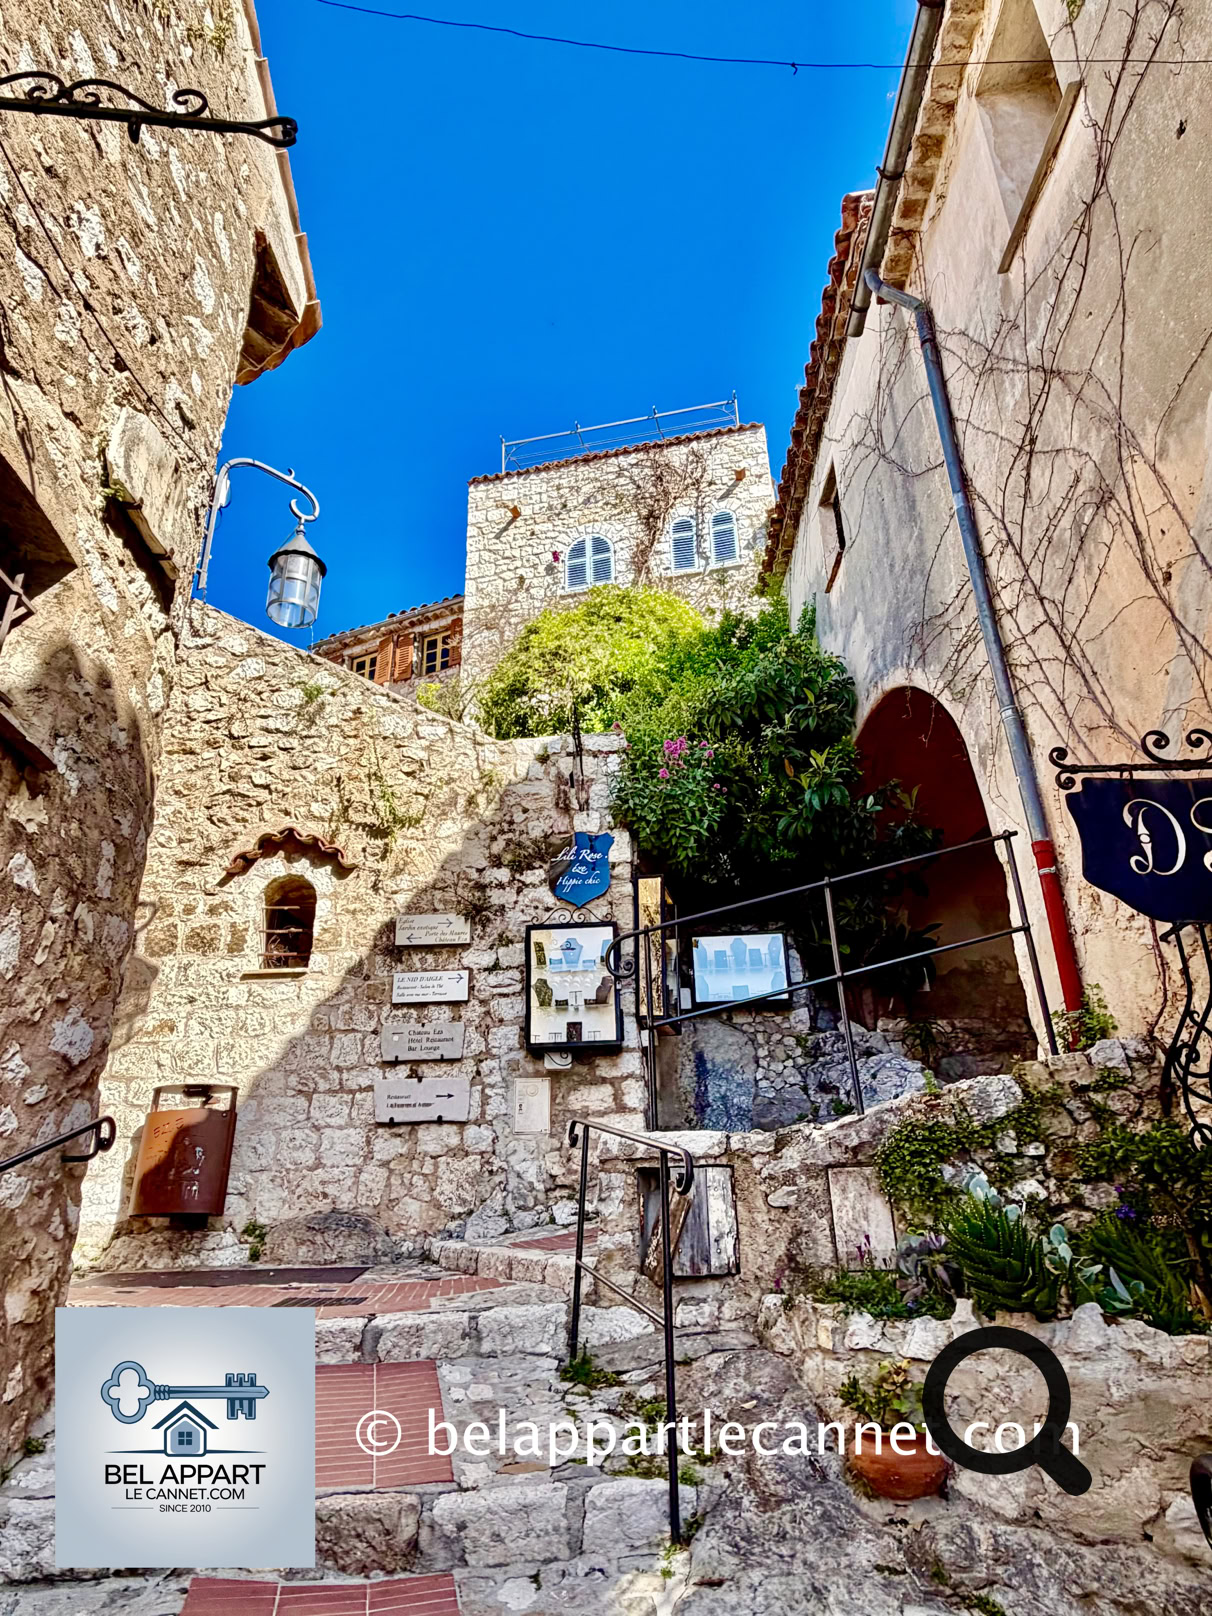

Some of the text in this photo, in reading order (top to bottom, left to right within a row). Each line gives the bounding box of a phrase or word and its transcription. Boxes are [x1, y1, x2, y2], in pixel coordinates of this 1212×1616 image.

[1122, 797, 1212, 876] D
[551, 845, 603, 863] Lili Rose
[556, 870, 601, 893] Hippie chic
